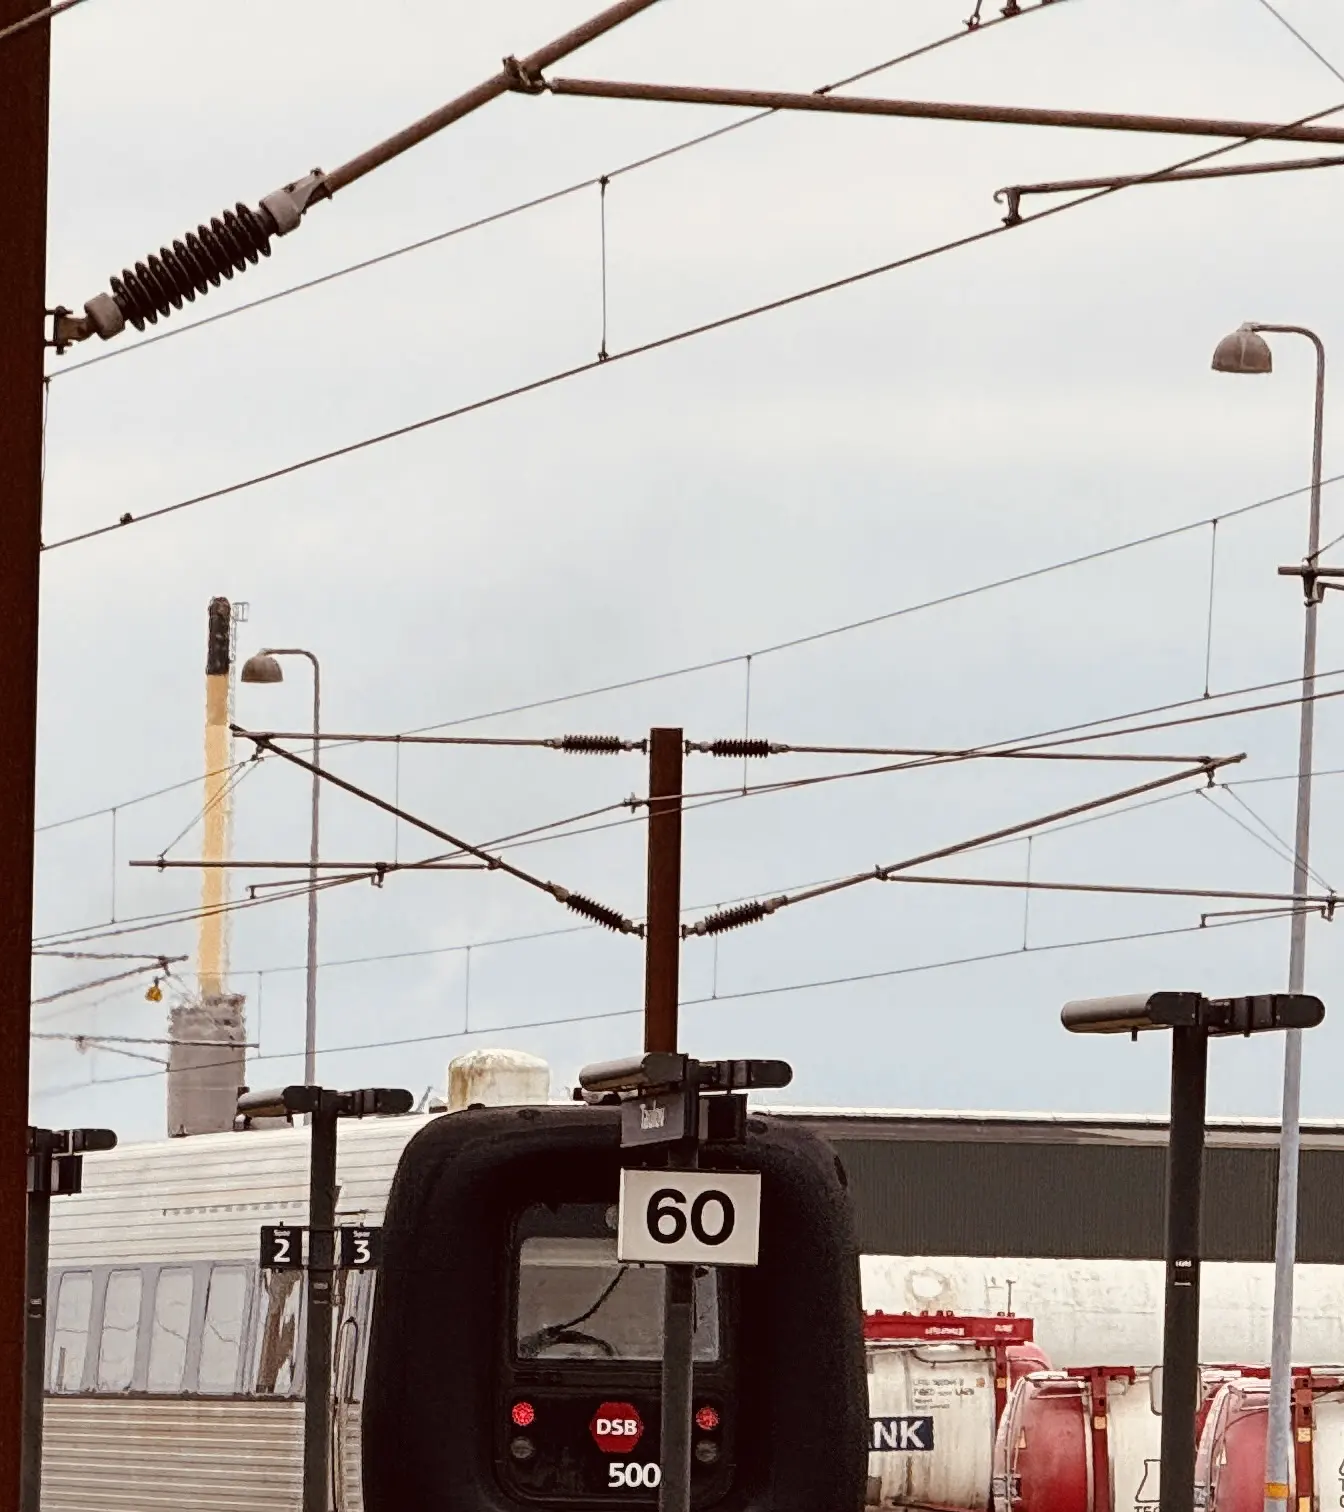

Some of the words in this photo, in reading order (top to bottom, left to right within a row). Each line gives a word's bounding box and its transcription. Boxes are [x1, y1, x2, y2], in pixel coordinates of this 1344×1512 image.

[646, 1188, 735, 1246] 60
[273, 1238, 291, 1263] 2
[352, 1239, 371, 1264] 3
[596, 1418, 638, 1436] DSB
[868, 1420, 925, 1449] NK
[607, 1462, 662, 1488] 500
